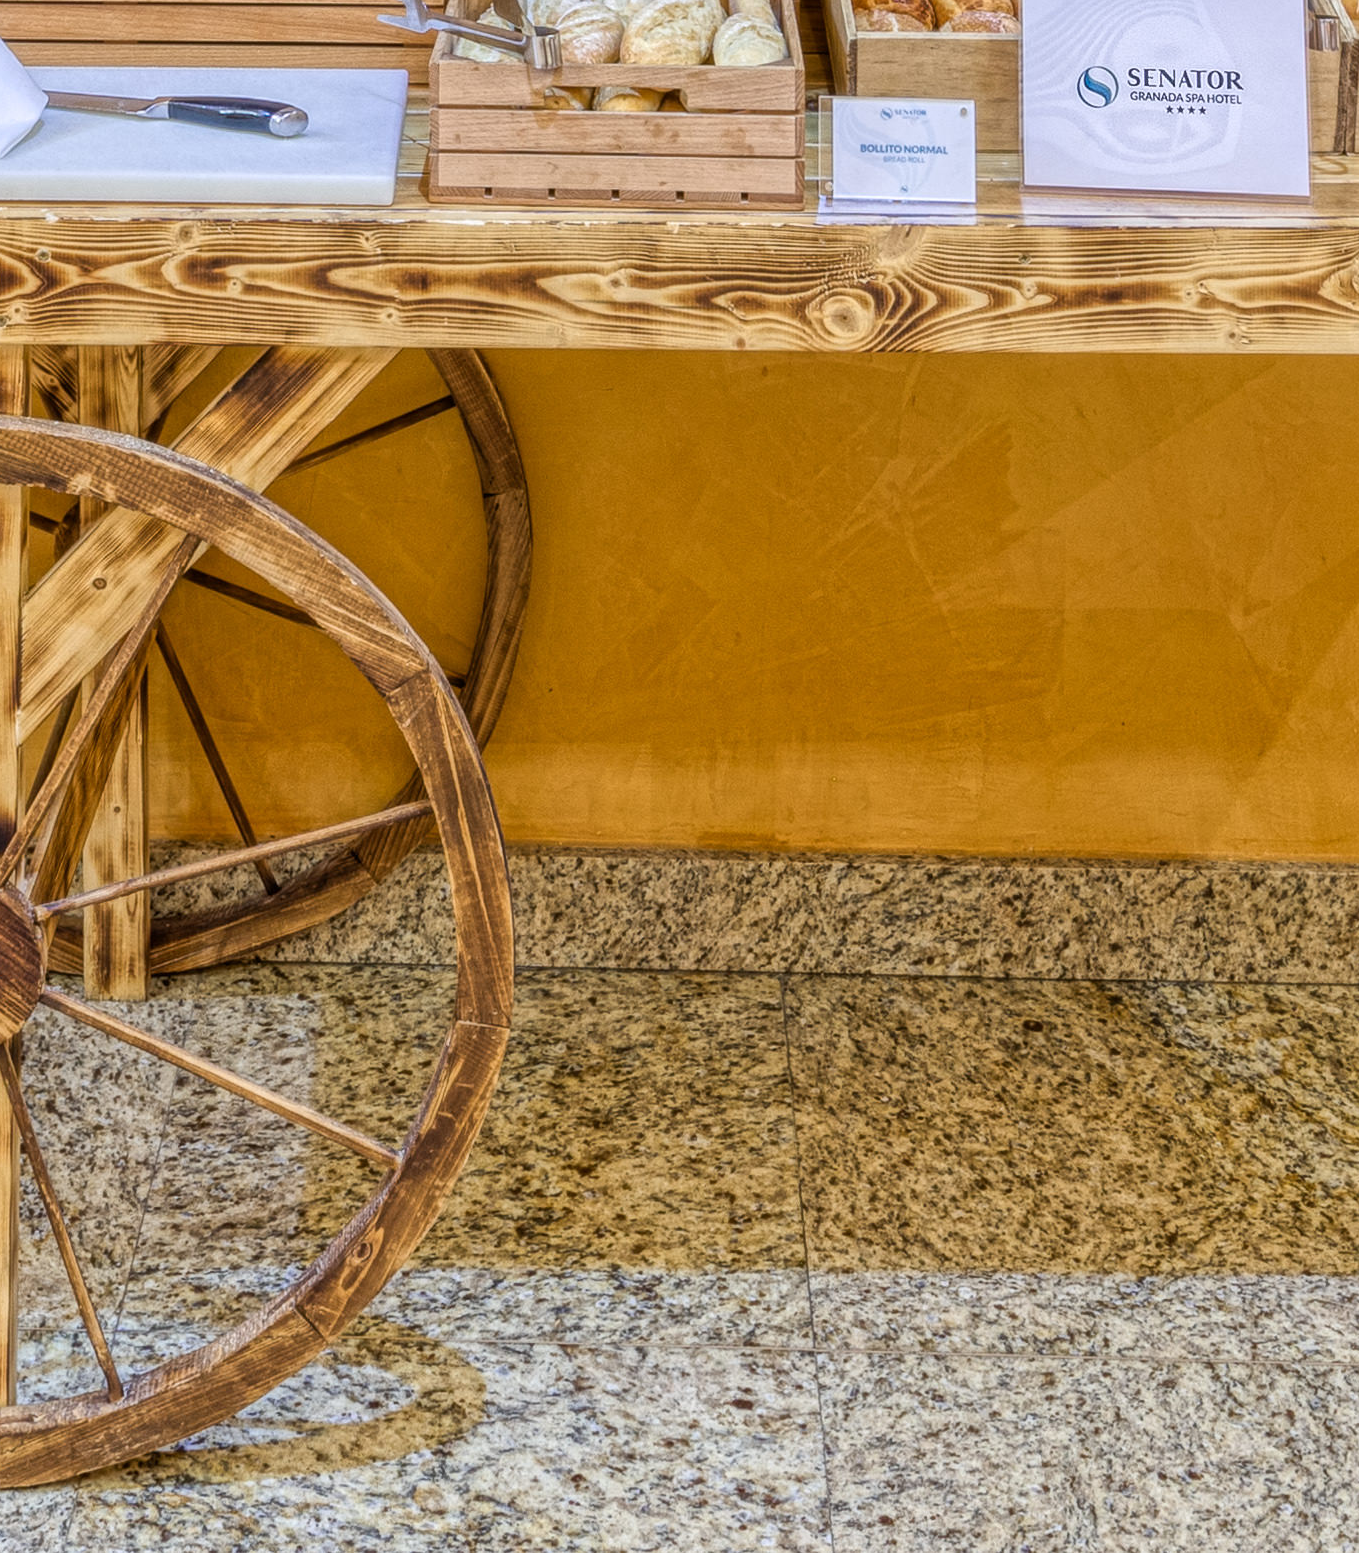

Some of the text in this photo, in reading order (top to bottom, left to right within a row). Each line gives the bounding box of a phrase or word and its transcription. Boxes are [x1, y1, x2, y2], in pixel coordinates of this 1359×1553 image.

[1127, 67, 1244, 91] SENATOR
[1130, 91, 1242, 105] GRANADA SPA HOTEL
[860, 144, 948, 155] BOLLITO NORMAL
